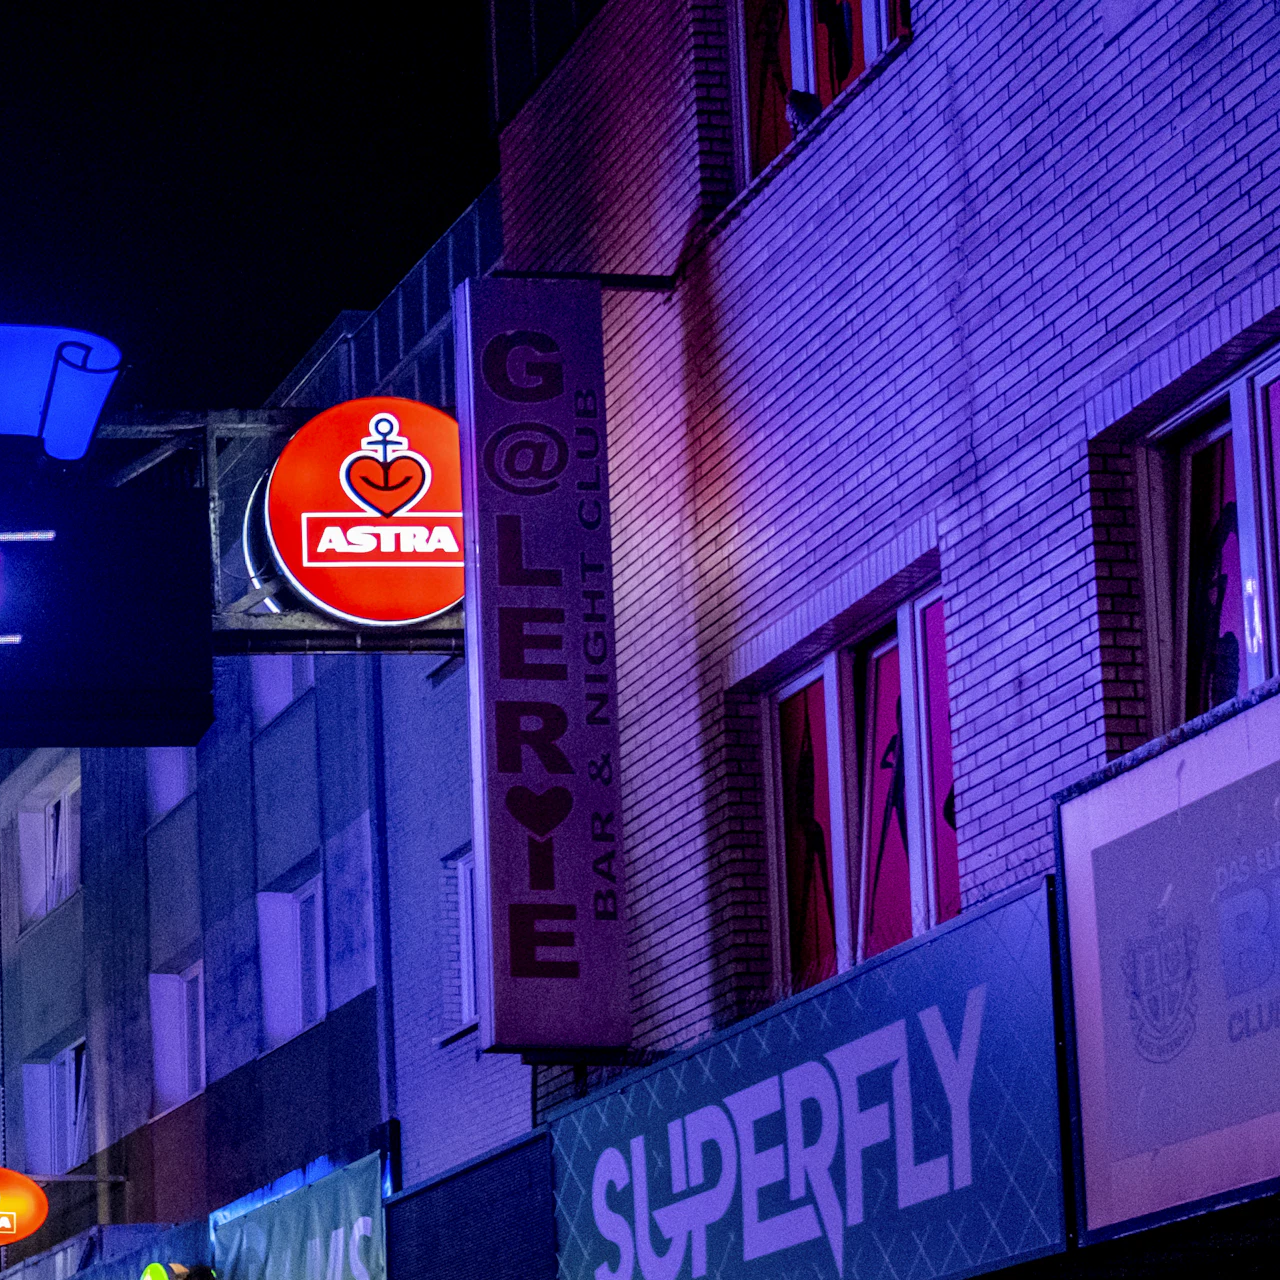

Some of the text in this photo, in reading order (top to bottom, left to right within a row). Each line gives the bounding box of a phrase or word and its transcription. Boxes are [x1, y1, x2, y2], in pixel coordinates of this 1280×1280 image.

[316, 526, 459, 554] ASTRA
[576, 388, 620, 922] BAR & NIGHT CLUB
